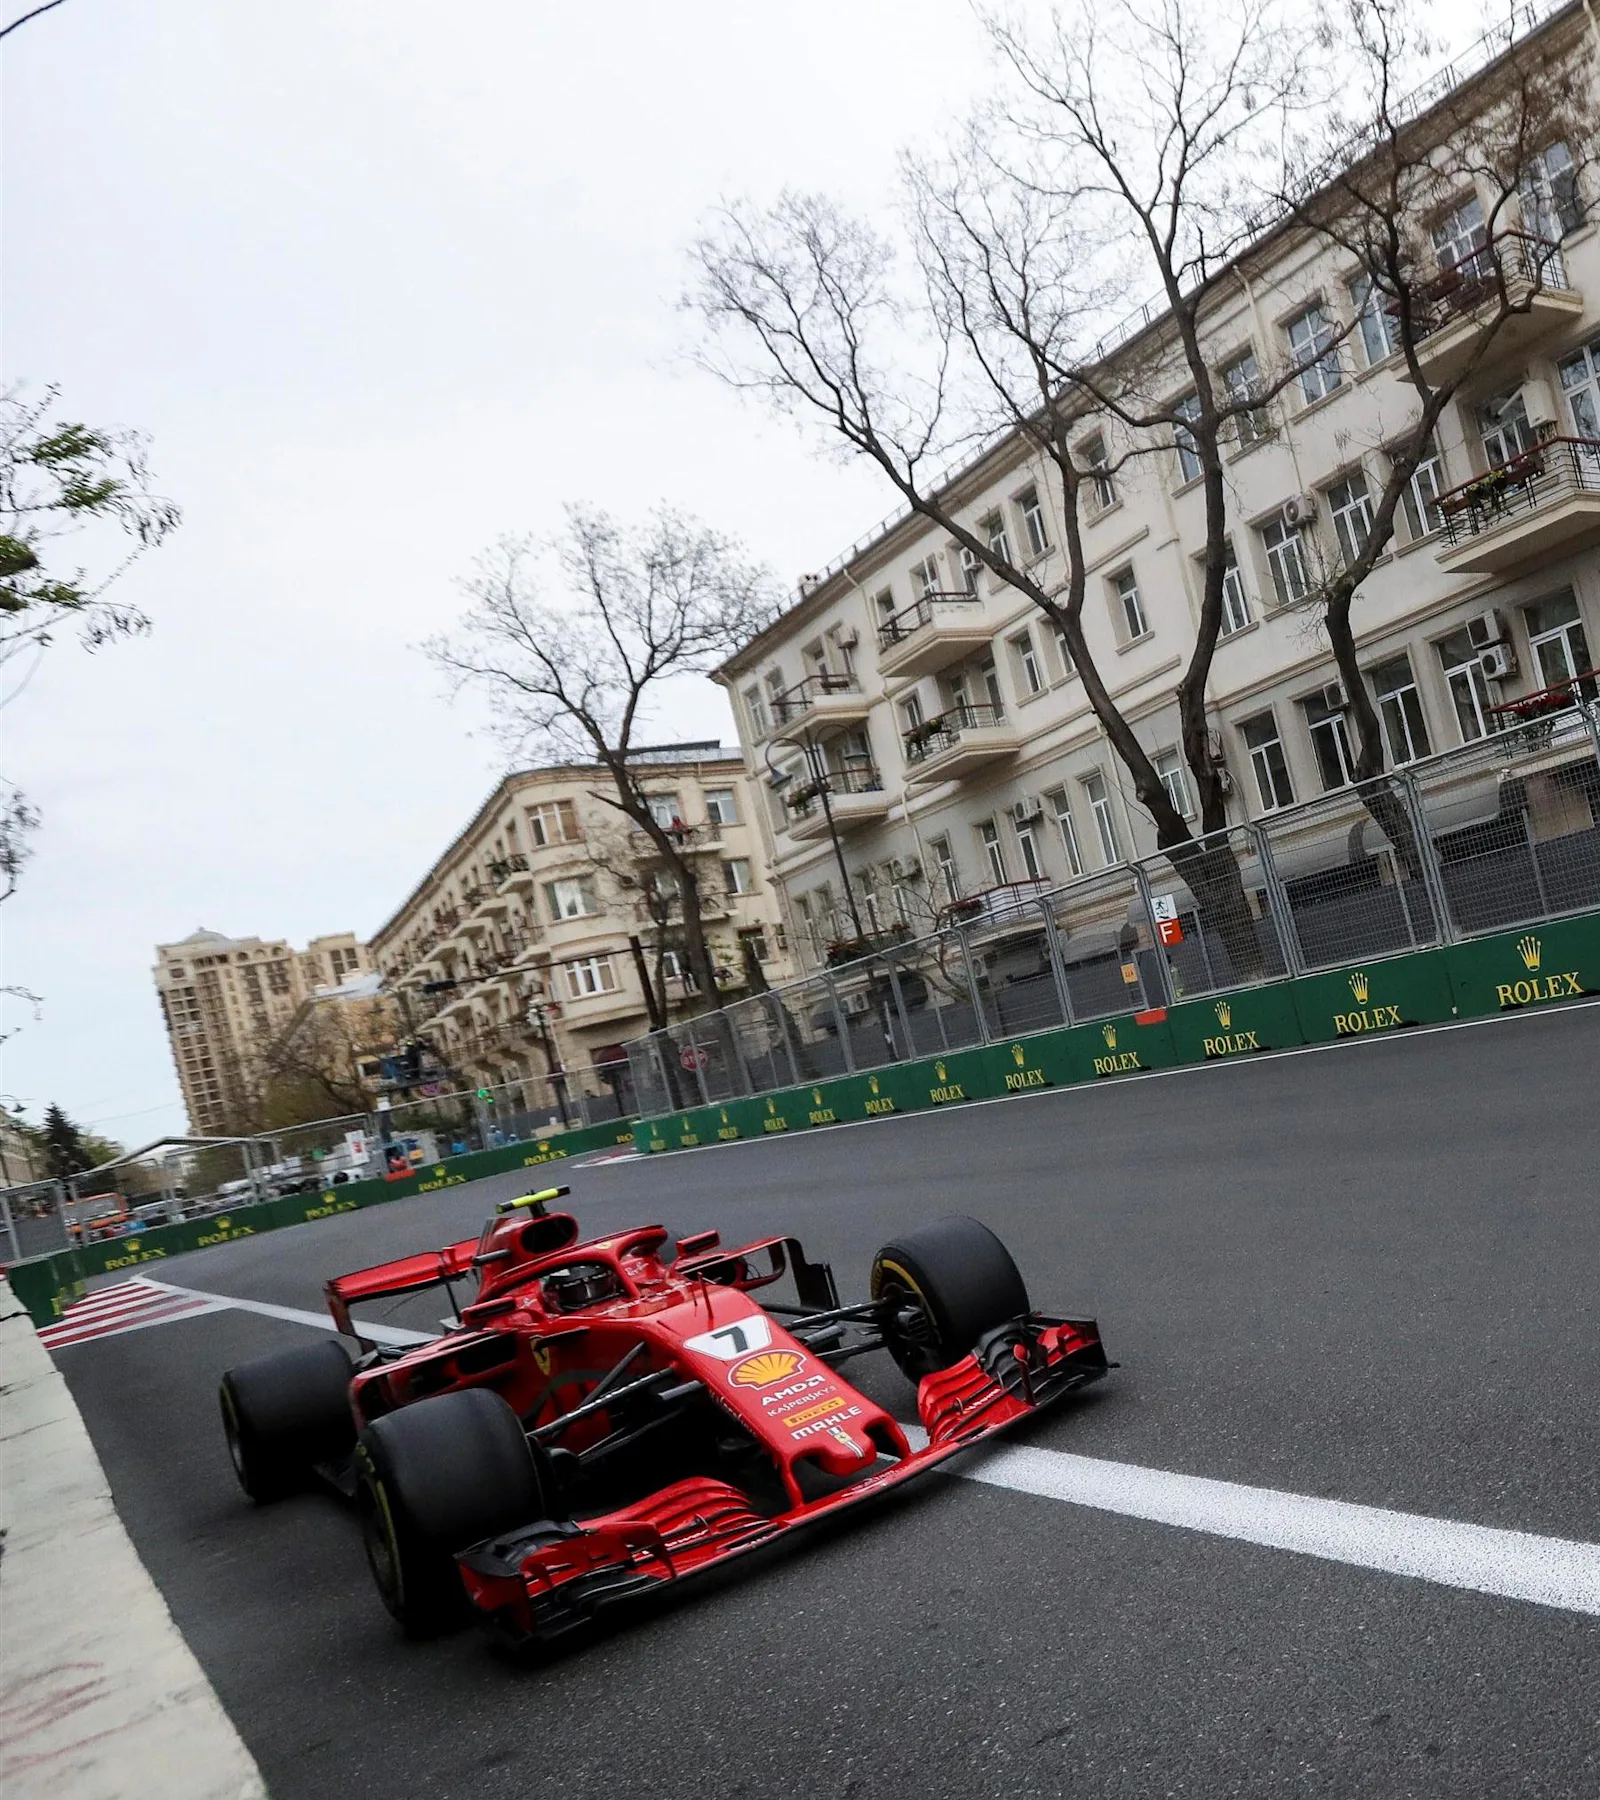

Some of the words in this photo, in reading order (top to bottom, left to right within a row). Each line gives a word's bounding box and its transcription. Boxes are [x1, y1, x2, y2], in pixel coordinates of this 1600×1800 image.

[1160, 922, 1173, 943] F
[1496, 970, 1586, 1007] ROLEX
[1333, 1005, 1404, 1035] ROLEX
[1203, 1031, 1260, 1056] ROLEX
[1093, 1051, 1141, 1075] ROLEX
[1005, 1069, 1046, 1090] ROLEX
[930, 1084, 965, 1103] ROLEX
[808, 1109, 836, 1125] ROLEX
[864, 1097, 895, 1115] ROLEX
[524, 1149, 568, 1166] ROLEX
[418, 1174, 466, 1192] ROLEX
[197, 1226, 255, 1247] ROLEX
[104, 1247, 168, 1271] ROLEX
[711, 1325, 750, 1355] 7
[767, 1387, 833, 1417] KASPERSKY
[791, 1405, 863, 1440] MAHLE
